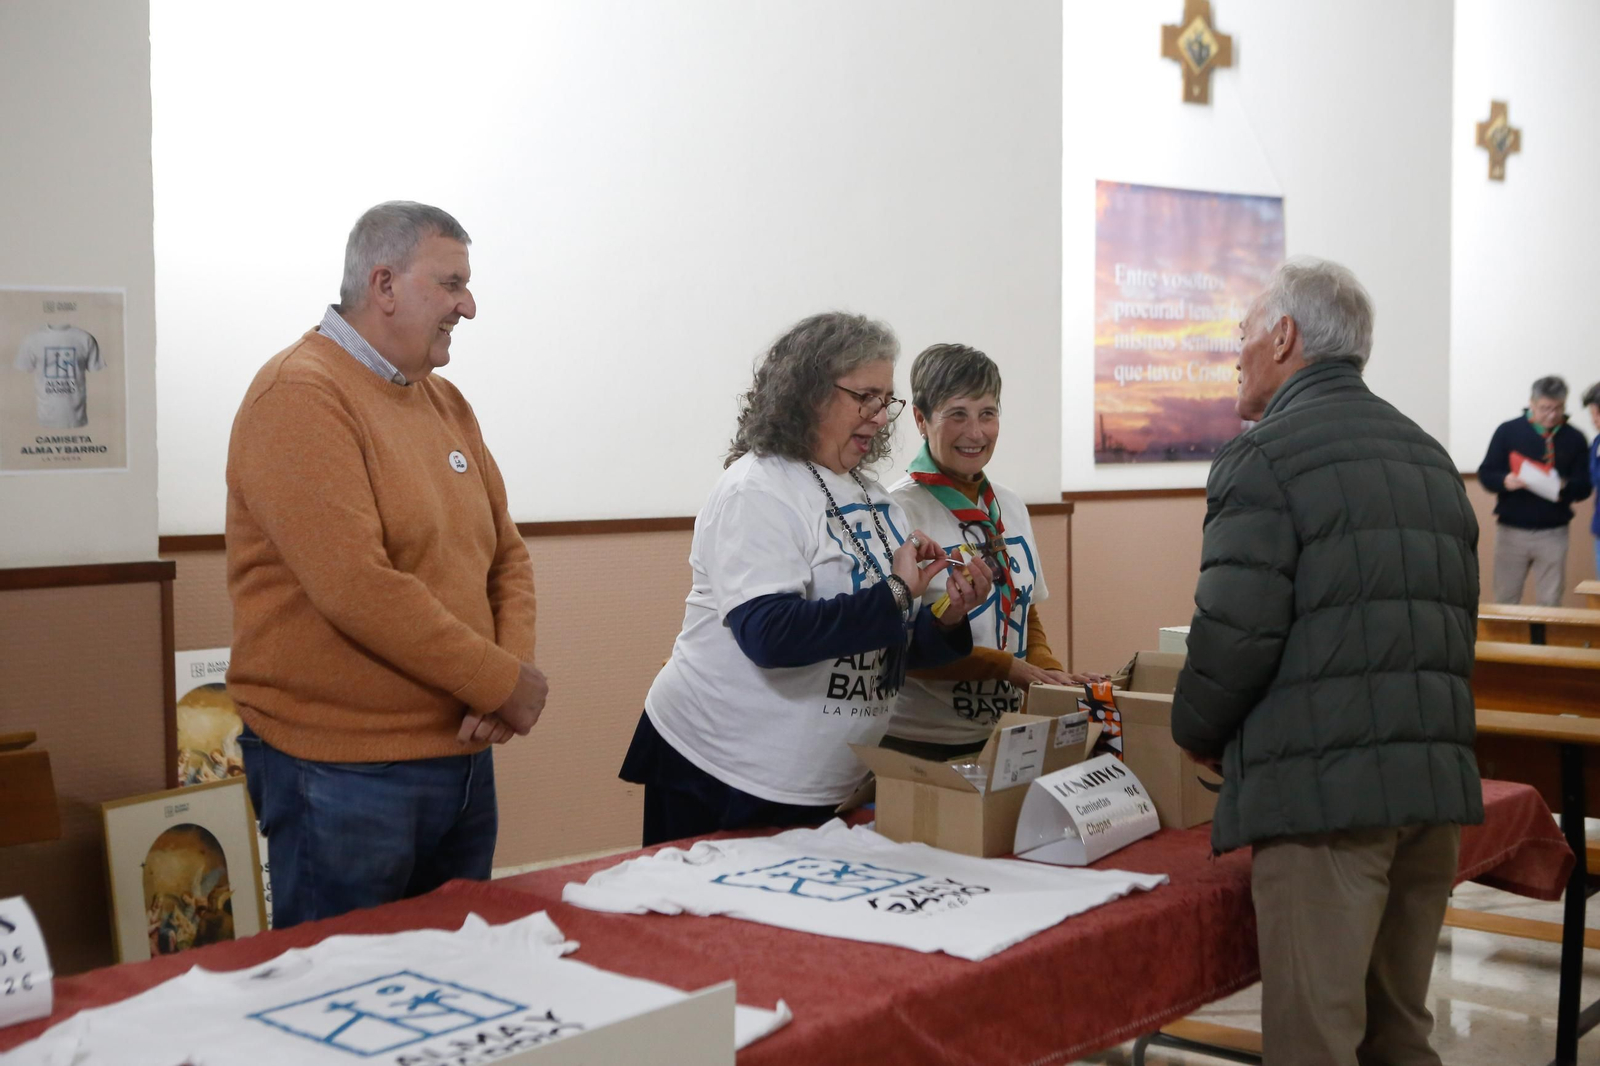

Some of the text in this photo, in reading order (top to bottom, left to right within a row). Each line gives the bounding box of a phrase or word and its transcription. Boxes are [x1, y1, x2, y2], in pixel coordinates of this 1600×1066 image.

[1115, 263, 1226, 291] Entre vosotros
[1114, 298, 1185, 323] procurad
[1189, 302, 1225, 321] tener
[1115, 326, 1176, 349] mismos
[1114, 360, 1234, 386] que tuvo Cristo
[21, 445, 108, 455] ALMA Y BARRIO
[35, 435, 92, 444] CAMISETA
[833, 648, 888, 671] ALM
[826, 673, 884, 701] BAR
[952, 680, 1015, 696] ALM
[823, 705, 841, 716] LA
[1076, 797, 1112, 816] Camisetas
[1086, 818, 1113, 836] Chapas
